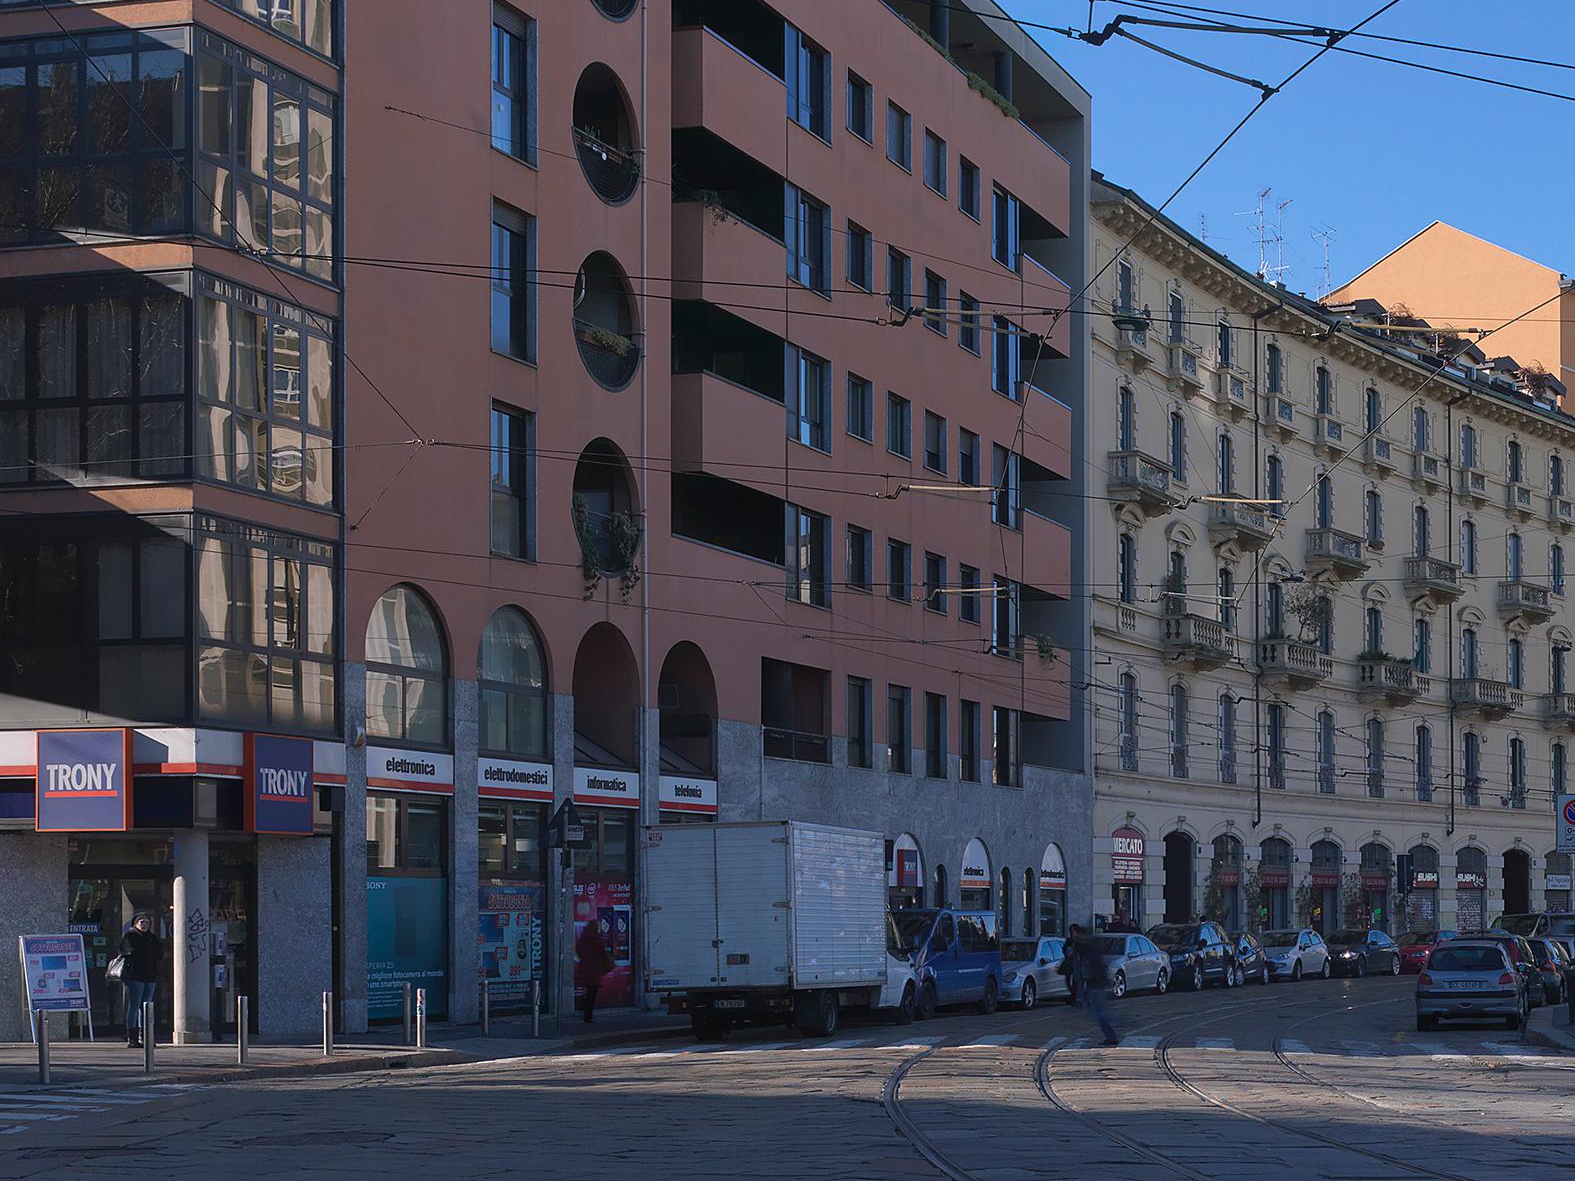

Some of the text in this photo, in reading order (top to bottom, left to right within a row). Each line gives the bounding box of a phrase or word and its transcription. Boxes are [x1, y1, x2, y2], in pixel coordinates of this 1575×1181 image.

[386, 757, 435, 776] elettronica
[484, 765, 548, 786] elettrodomestici
[46, 763, 117, 791] TRONY
[259, 768, 308, 796] TRONY
[587, 775, 627, 792] informatica
[674, 784, 702, 799] telefonia
[1113, 837, 1143, 855] MERCATO
[1417, 873, 1437, 882] SUSHI
[69, 924, 99, 934] ENTRATA
[532, 916, 542, 966] TRONY
[371, 972, 392, 981] migliore
[393, 970, 420, 979] fotocamera
